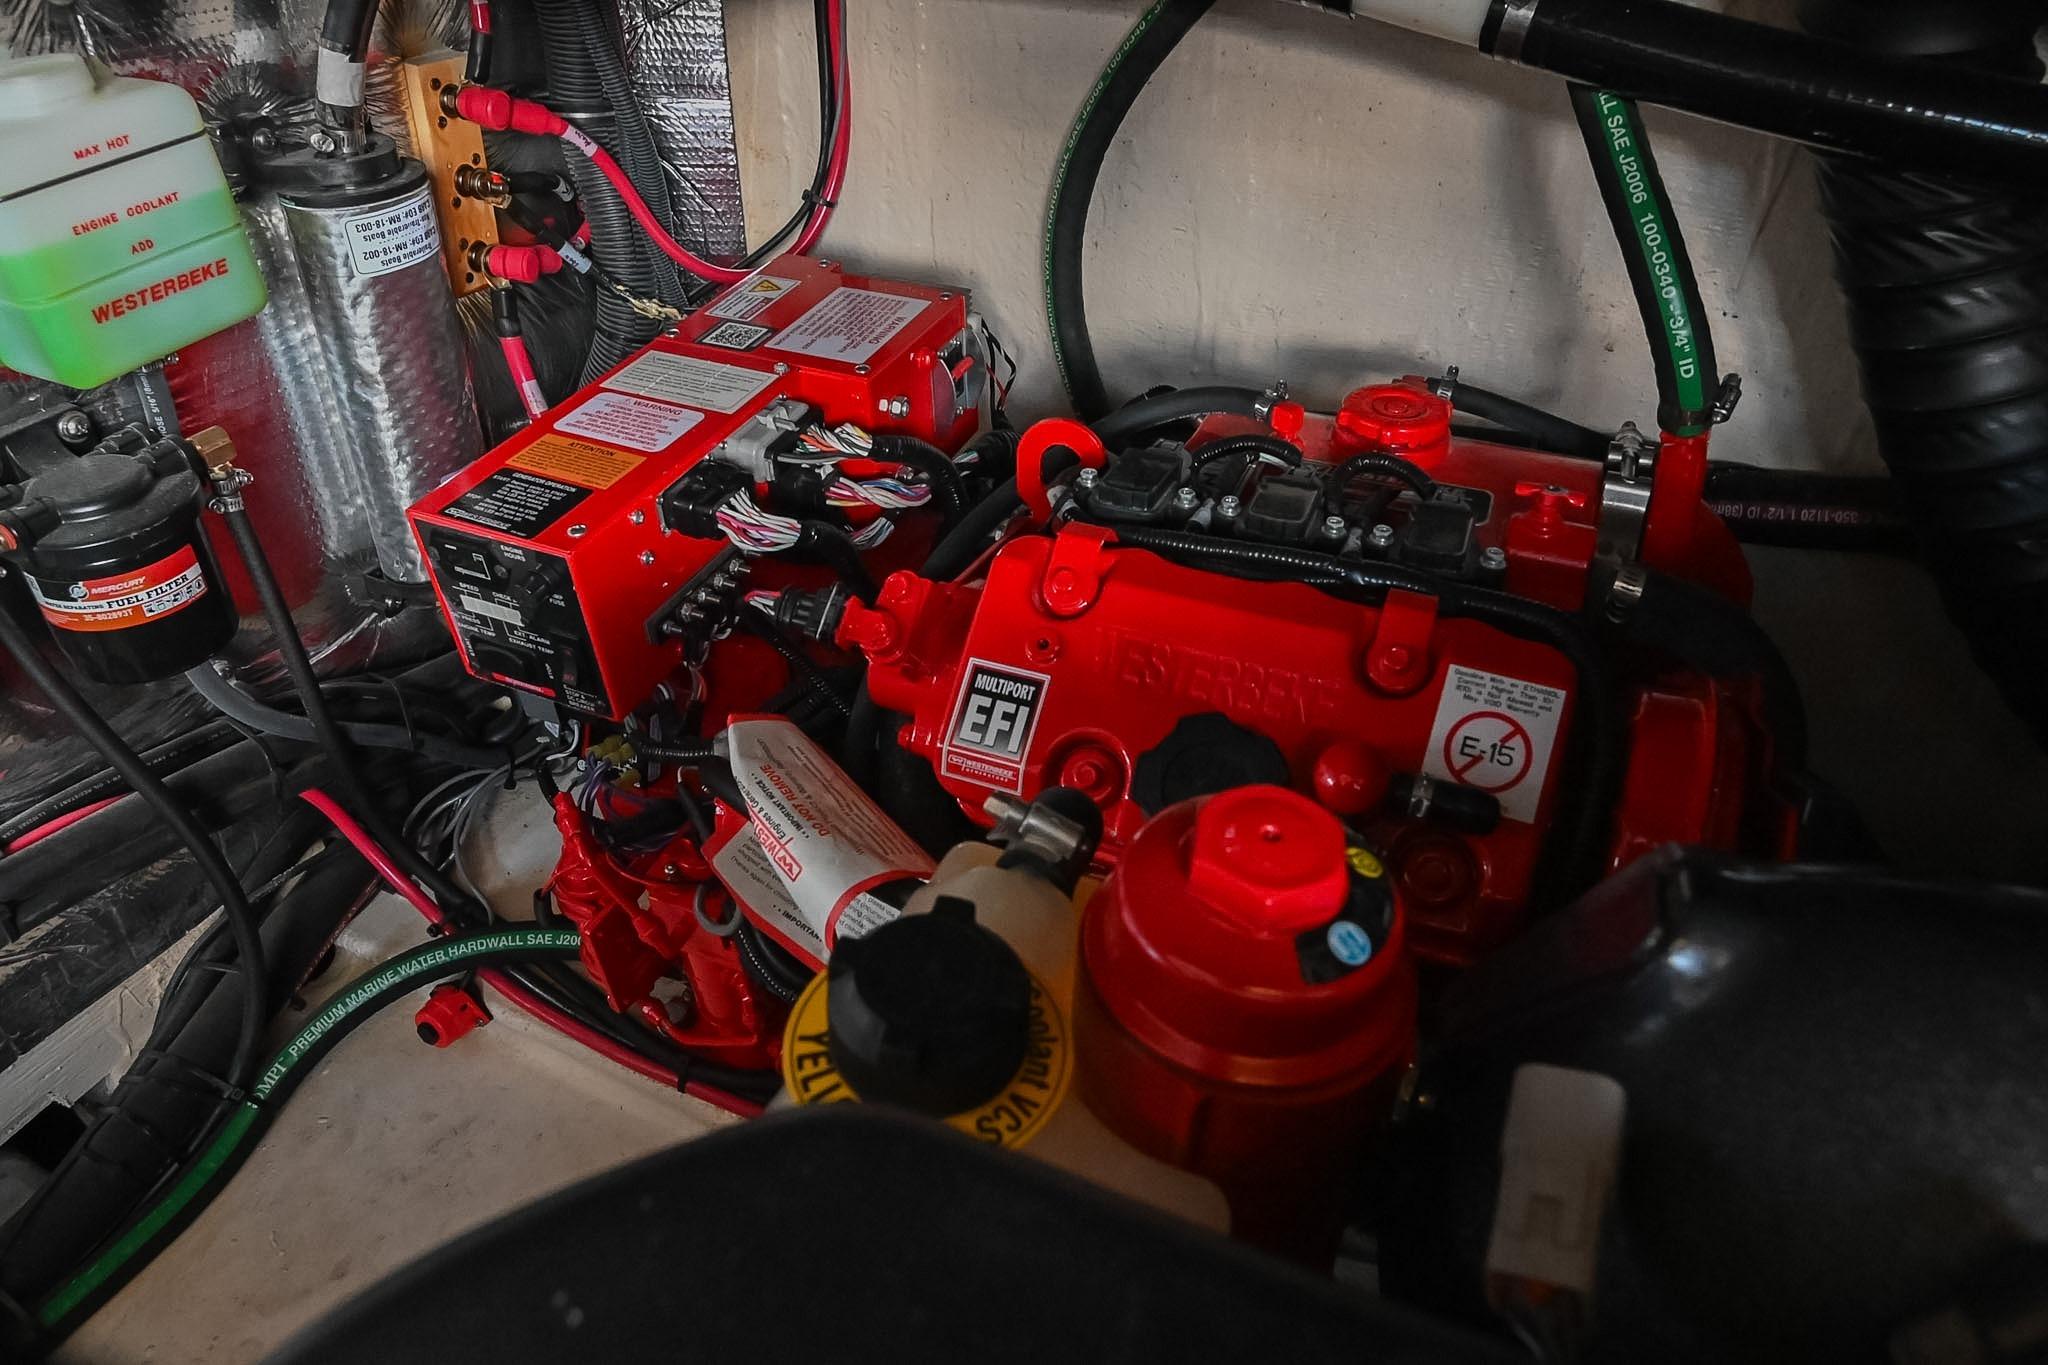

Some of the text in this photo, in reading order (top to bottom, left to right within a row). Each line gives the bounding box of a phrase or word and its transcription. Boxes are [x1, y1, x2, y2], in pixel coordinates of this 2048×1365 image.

[1608, 115, 1630, 151] SAE
[74, 135, 130, 161] MAX HOT
[1619, 154, 1648, 205] J2006
[72, 192, 180, 236] ENGINE COOLANT
[355, 215, 402, 233] RM-18-003
[130, 239, 155, 256] ADD
[363, 230, 386, 242] Boats
[363, 241, 408, 261] RM-18-002
[1639, 212, 1676, 298] 100-0340
[91, 258, 229, 324] WESTERBEKE
[1669, 315, 1691, 353] 3/4"
[1679, 358, 1695, 379] ID
[633, 399, 683, 416] WARNING
[568, 441, 617, 457] ATTENTION
[503, 551, 527, 563] HOURS
[91, 576, 146, 594] MERCURY
[106, 594, 144, 609] FUEL
[146, 573, 190, 600] FILTER
[458, 581, 480, 592] SPEED
[974, 673, 1036, 701] MULTIPORT
[960, 693, 1030, 753] EFI
[1460, 735, 1516, 767] E-15
[760, 763, 797, 801] REMOVE
[763, 811, 786, 840] Engines
[773, 799, 803, 832] IMPORTANT
[792, 803, 815, 824] NOT
[812, 823, 830, 836] DO
[288, 1004, 345, 1059] PREMIUM
[345, 971, 398, 1007] MARINE
[397, 951, 446, 976] WATER
[446, 935, 524, 958] HARDWALL
[527, 934, 553, 946] SAE
[975, 1093, 1041, 1146] VCS
